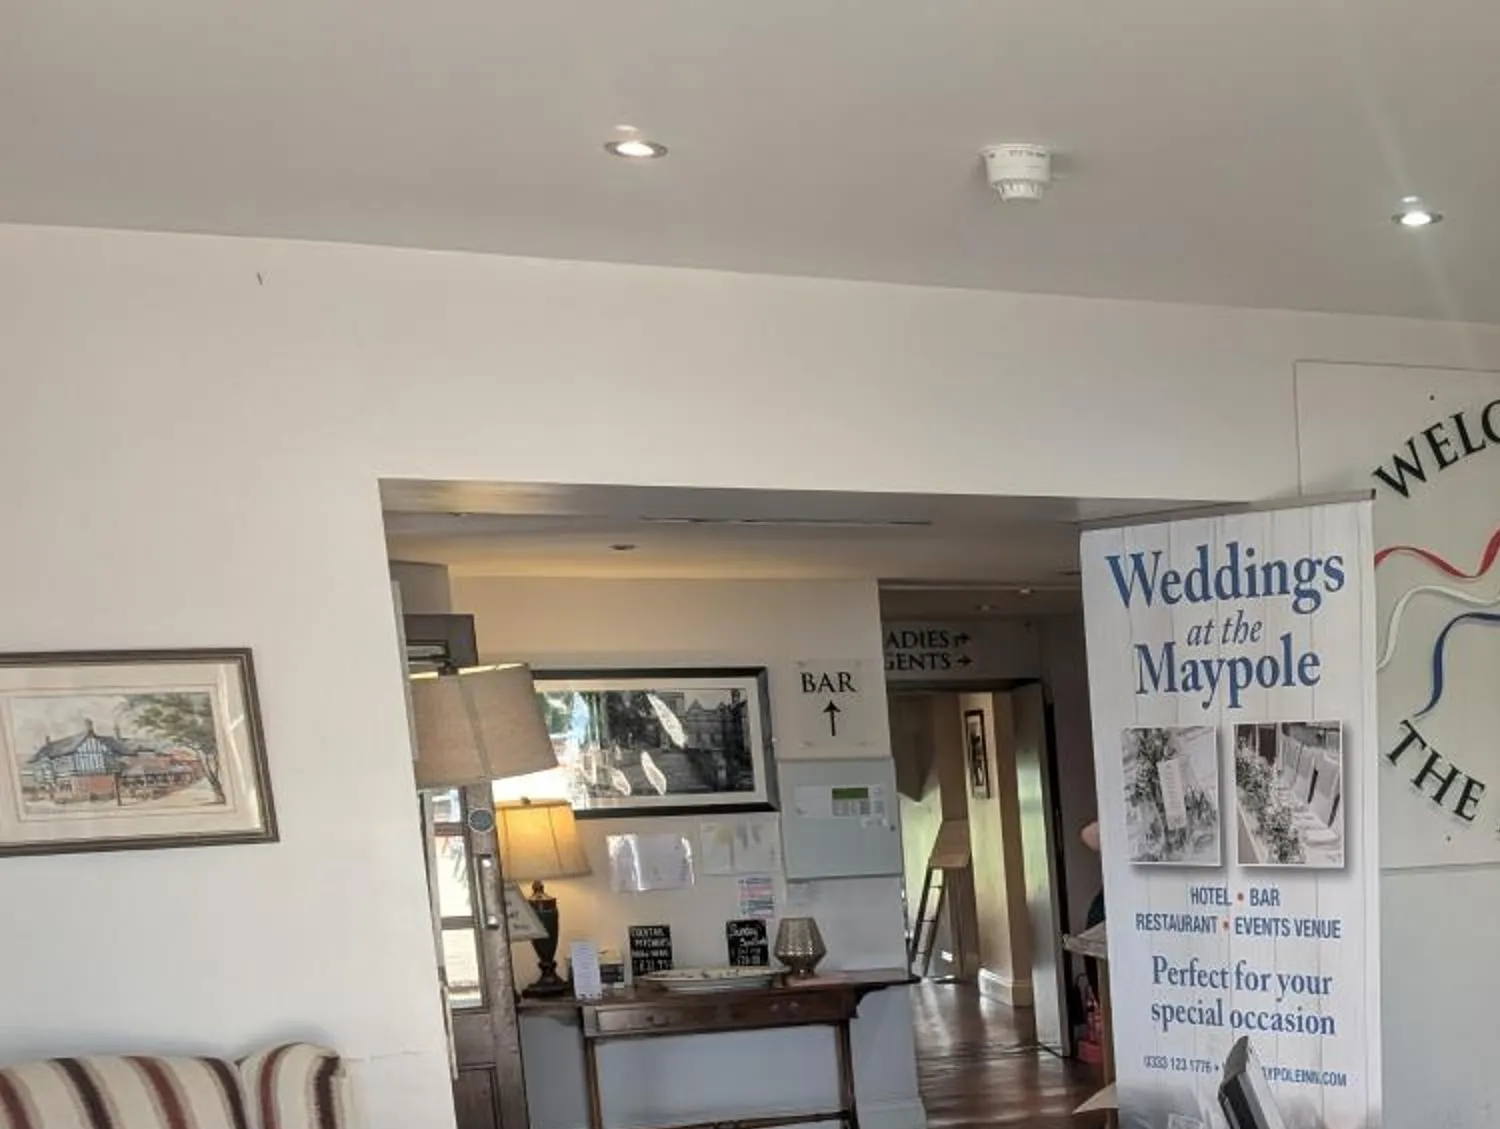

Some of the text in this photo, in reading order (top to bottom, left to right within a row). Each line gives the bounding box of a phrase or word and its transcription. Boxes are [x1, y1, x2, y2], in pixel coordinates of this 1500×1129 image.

[1104, 541, 1345, 614] Weddings
[885, 630, 949, 649] ADIES
[1187, 609, 1263, 646] at the
[800, 671, 856, 693] BAR
[1134, 632, 1320, 709] Maypole
[1386, 719, 1485, 822] THE
[1191, 886, 1280, 907] HOTEL BAR
[1136, 913, 1341, 939] RESTAURANT EVENTS VENUE
[1152, 955, 1333, 1002] Perfect for your
[1151, 998, 1336, 1036] special occasion
[1171, 1057, 1187, 1071] 123
[1262, 1066, 1347, 1087] YPOLEINN.COM
